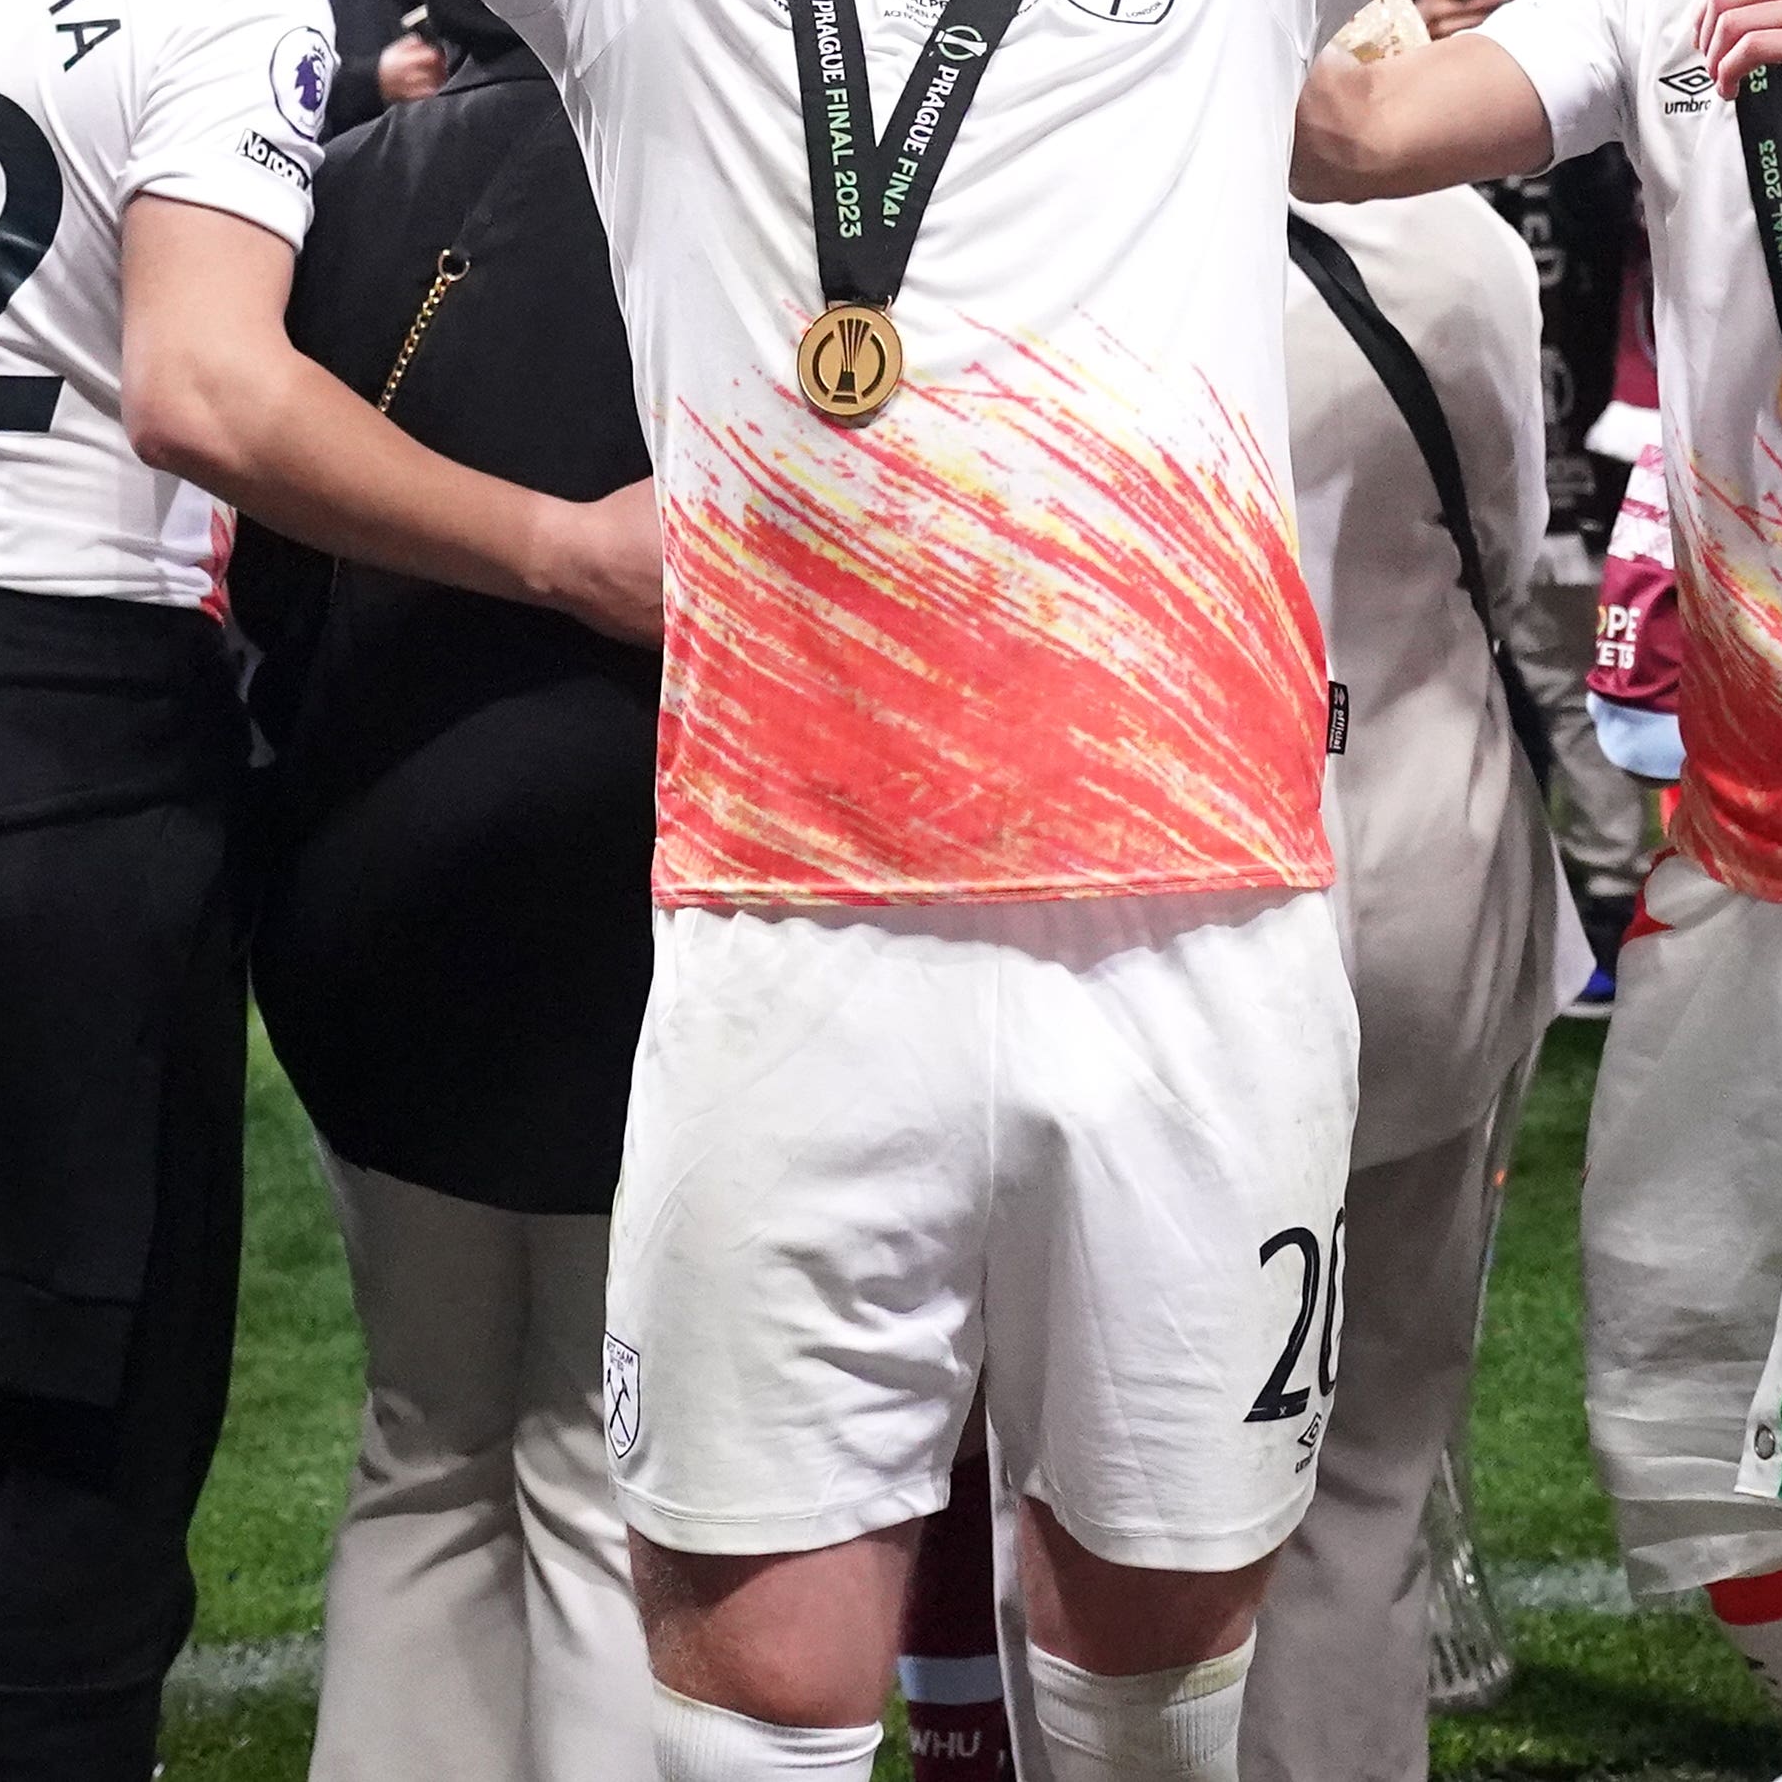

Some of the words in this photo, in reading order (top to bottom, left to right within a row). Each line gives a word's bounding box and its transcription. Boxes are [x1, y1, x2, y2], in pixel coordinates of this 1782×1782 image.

[1125, 0, 1163, 18] LONDON
[825, 87, 855, 167] FINAL
[902, 64, 961, 156] PRAGUE
[236, 128, 269, 162] No
[1758, 138, 1782, 200] 2023
[834, 170, 862, 239] 2023
